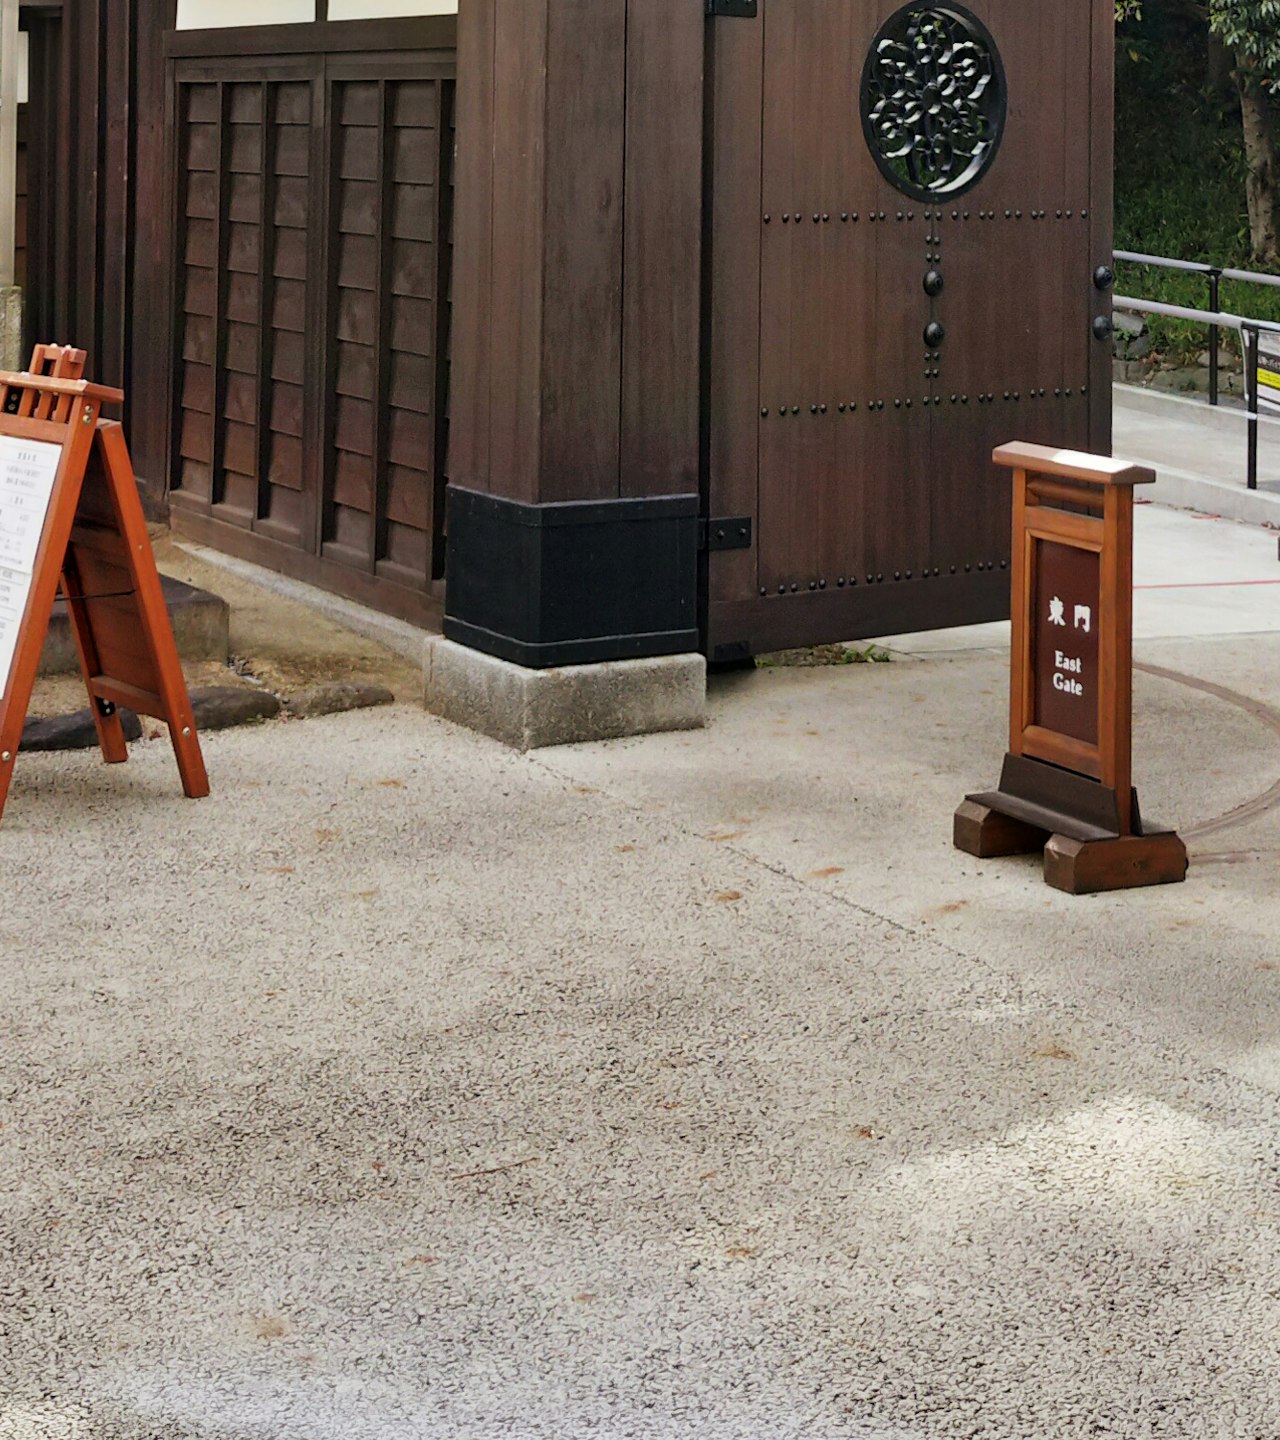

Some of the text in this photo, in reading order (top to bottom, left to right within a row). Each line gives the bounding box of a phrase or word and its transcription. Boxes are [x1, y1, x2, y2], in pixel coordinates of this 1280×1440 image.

[1047, 595, 1091, 633] 東門
[1054, 649, 1082, 673] East
[1052, 672, 1083, 696] Gate
